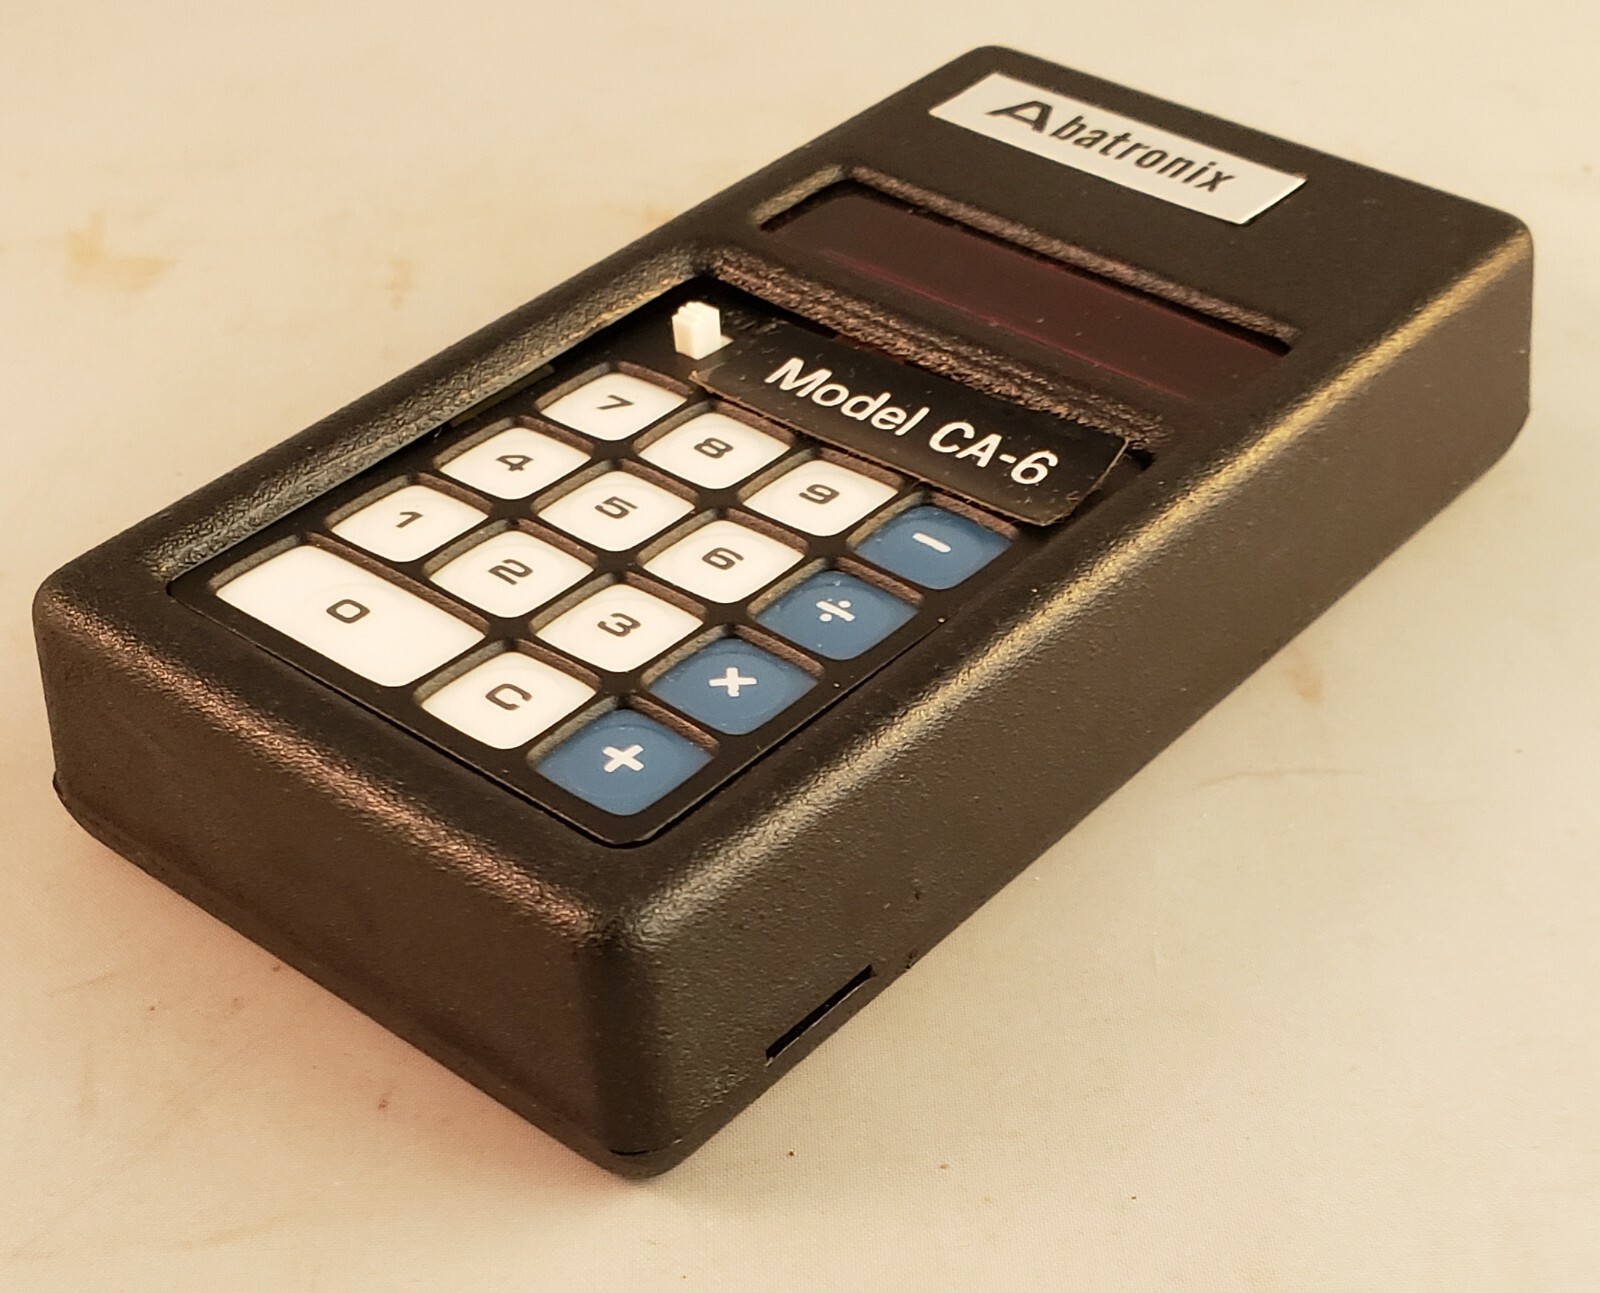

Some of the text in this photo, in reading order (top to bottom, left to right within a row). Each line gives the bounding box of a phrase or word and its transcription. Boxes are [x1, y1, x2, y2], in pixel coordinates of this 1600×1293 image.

[986, 100, 1236, 193] Abatronix
[597, 394, 634, 411] 7
[764, 357, 1059, 485] Model CA-6
[693, 437, 734, 459] 8
[496, 454, 534, 472] 4
[799, 483, 840, 505] 9
[395, 511, 424, 529] 1
[594, 496, 638, 520] 5
[701, 547, 745, 571] 6
[488, 558, 534, 586] 2
[326, 598, 371, 624] 0
[597, 612, 642, 638] 3
[485, 683, 533, 711] C
